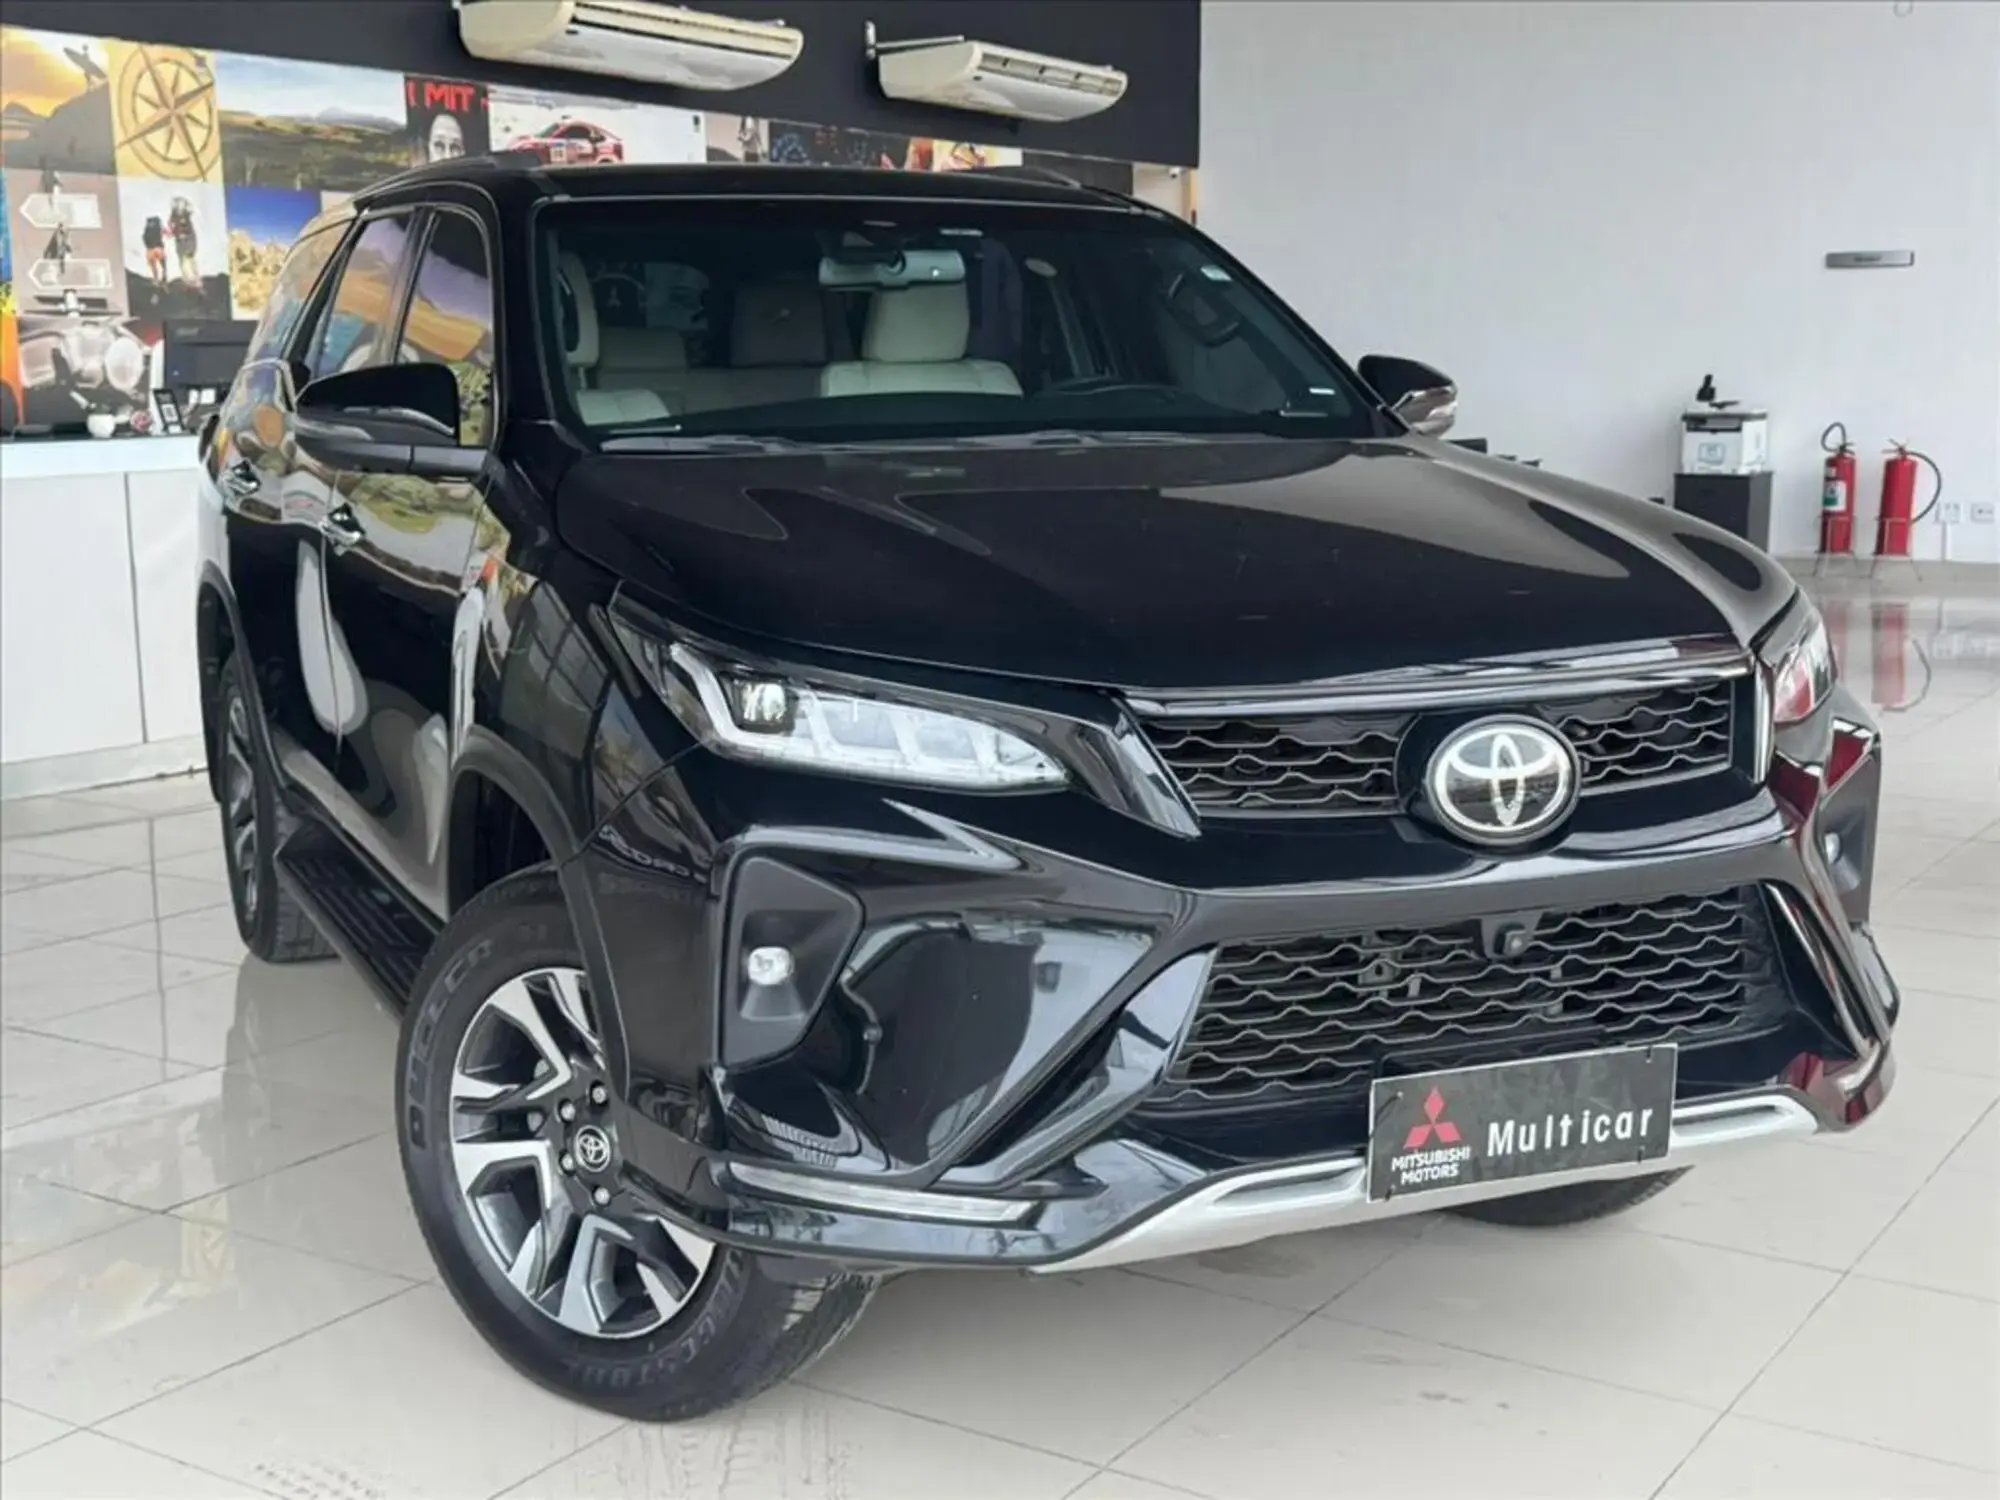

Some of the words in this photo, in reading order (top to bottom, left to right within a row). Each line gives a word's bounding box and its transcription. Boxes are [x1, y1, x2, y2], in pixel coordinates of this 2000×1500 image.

[424, 81, 475, 112] MIT
[1487, 1108, 1653, 1157] Multicar
[1391, 1146, 1472, 1171] MITSUBISHI
[1400, 1161, 1459, 1184] MOTORS
